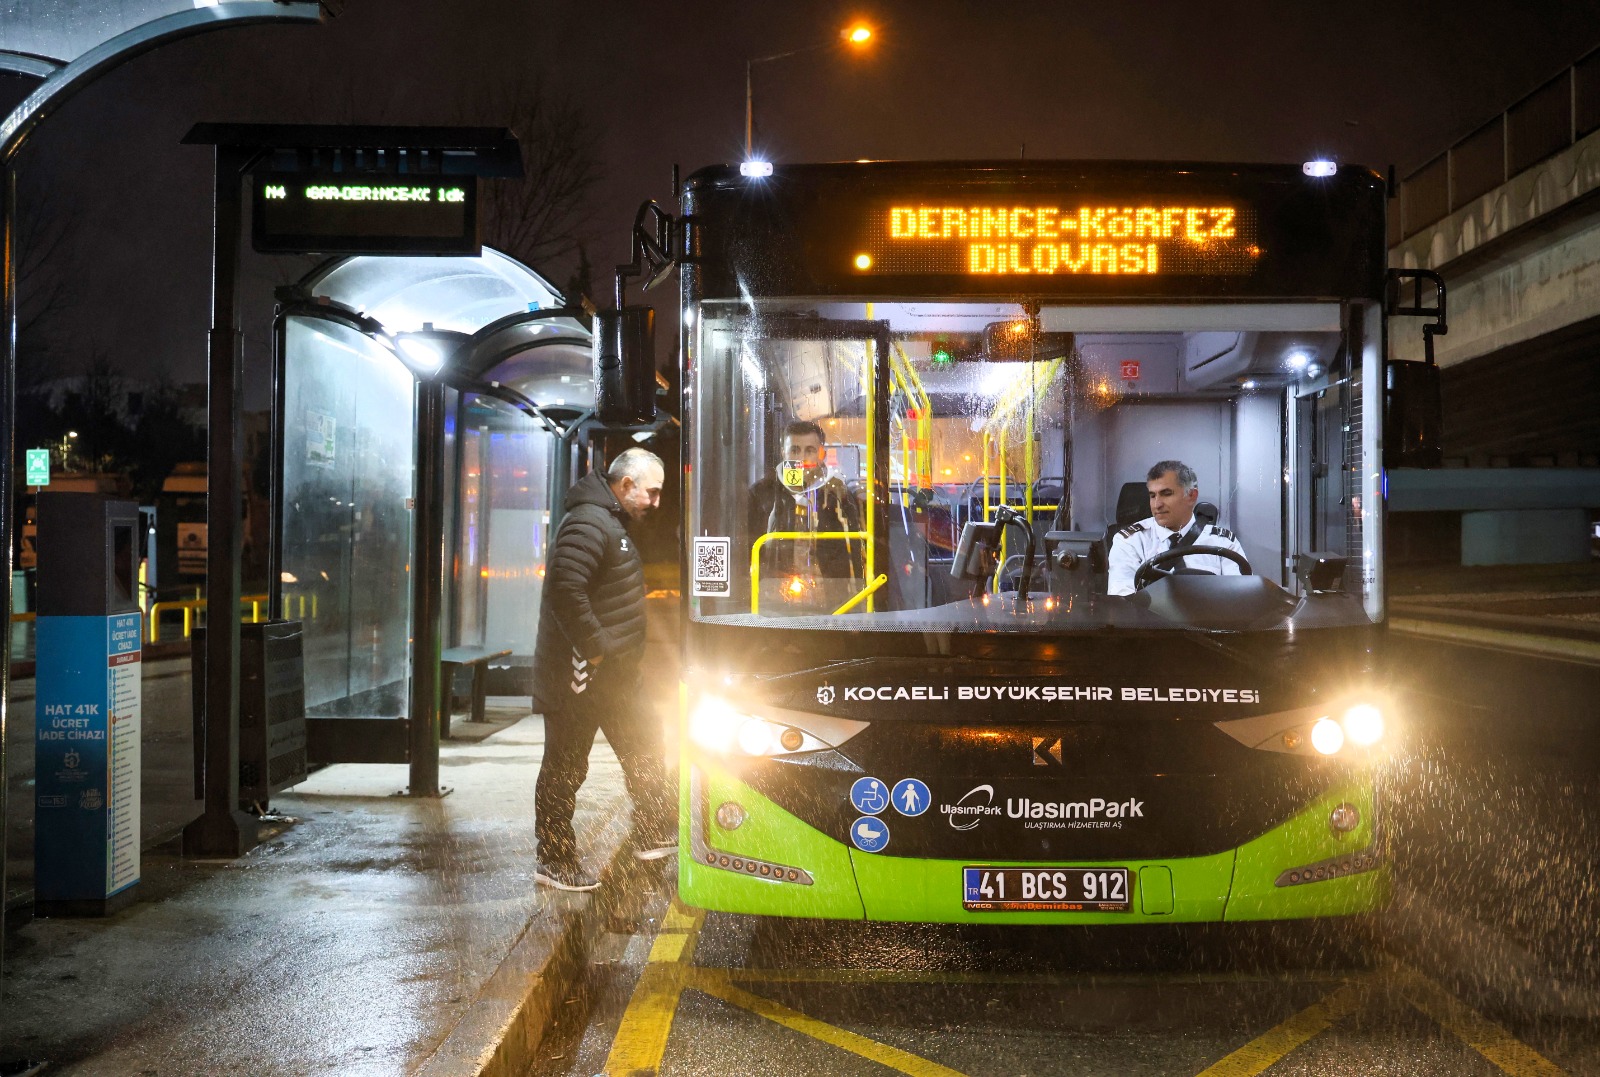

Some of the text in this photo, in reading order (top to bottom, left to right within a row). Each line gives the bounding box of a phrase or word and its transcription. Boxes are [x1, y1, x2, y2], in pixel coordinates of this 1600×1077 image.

[265, 185, 287, 199] N4
[45, 704, 99, 715] HAT 41K
[52, 716, 90, 728] ÜCRET
[39, 728, 105, 740] İADE CİHAZI
[1024, 821, 1066, 830] ULAŞTIRMA
[968, 887, 979, 895] TR
[979, 872, 1124, 899] 41 BCS 912
